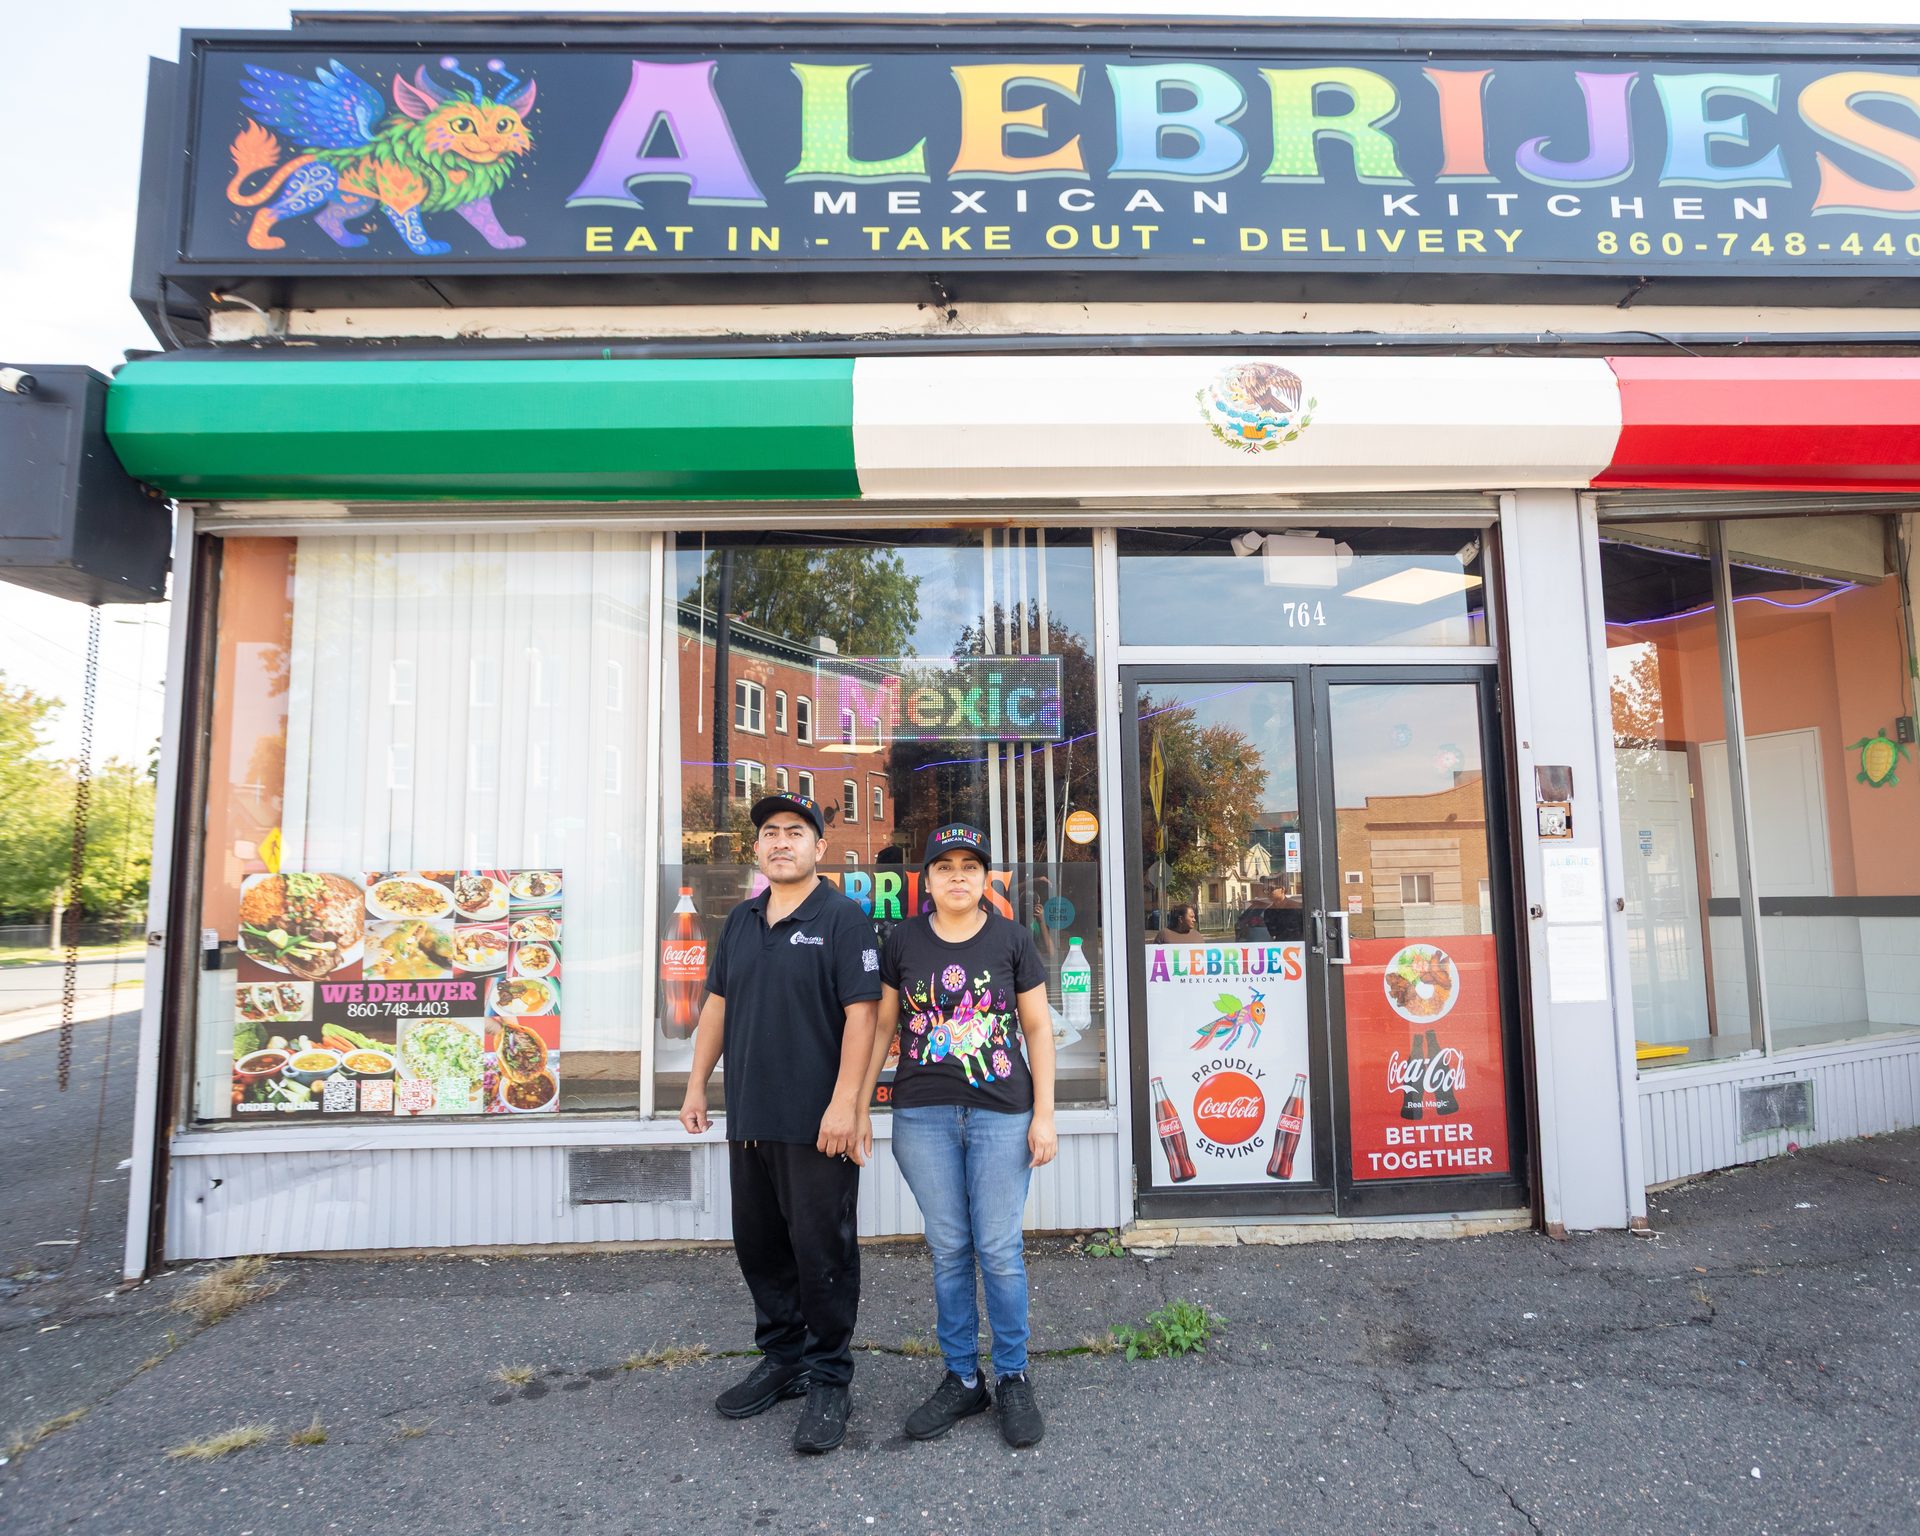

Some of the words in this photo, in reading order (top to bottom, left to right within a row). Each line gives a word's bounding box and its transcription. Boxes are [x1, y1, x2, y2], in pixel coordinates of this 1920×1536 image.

[566, 60, 1920, 219] ALEBRIJES
[813, 188, 1228, 216] MEXICAN
[1382, 192, 1768, 220] KITCHEN
[585, 226, 693, 252] EAT
[728, 226, 780, 252] IN
[862, 225, 1012, 252] TAKE
[1044, 225, 1160, 250] OUT
[1239, 227, 1524, 253] DELIVERY
[1283, 600, 1327, 628] 764
[935, 828, 982, 844] ALEBRIJES
[1150, 946, 1302, 983] ALEBRIJES
[1235, 976, 1275, 984] FUSION
[321, 984, 364, 1003] WE
[367, 981, 477, 1002] DELIVER
[347, 1002, 450, 1017] 860-748-4403
[1192, 1058, 1266, 1083] PROUDLY
[236, 1102, 276, 1112] ORDER
[277, 1101, 319, 1111] ONLINE
[1407, 1100, 1424, 1109] Real
[1386, 1124, 1473, 1145] BETTER
[1196, 1137, 1264, 1159] SERVING
[1368, 1147, 1493, 1171] TOGETHER
